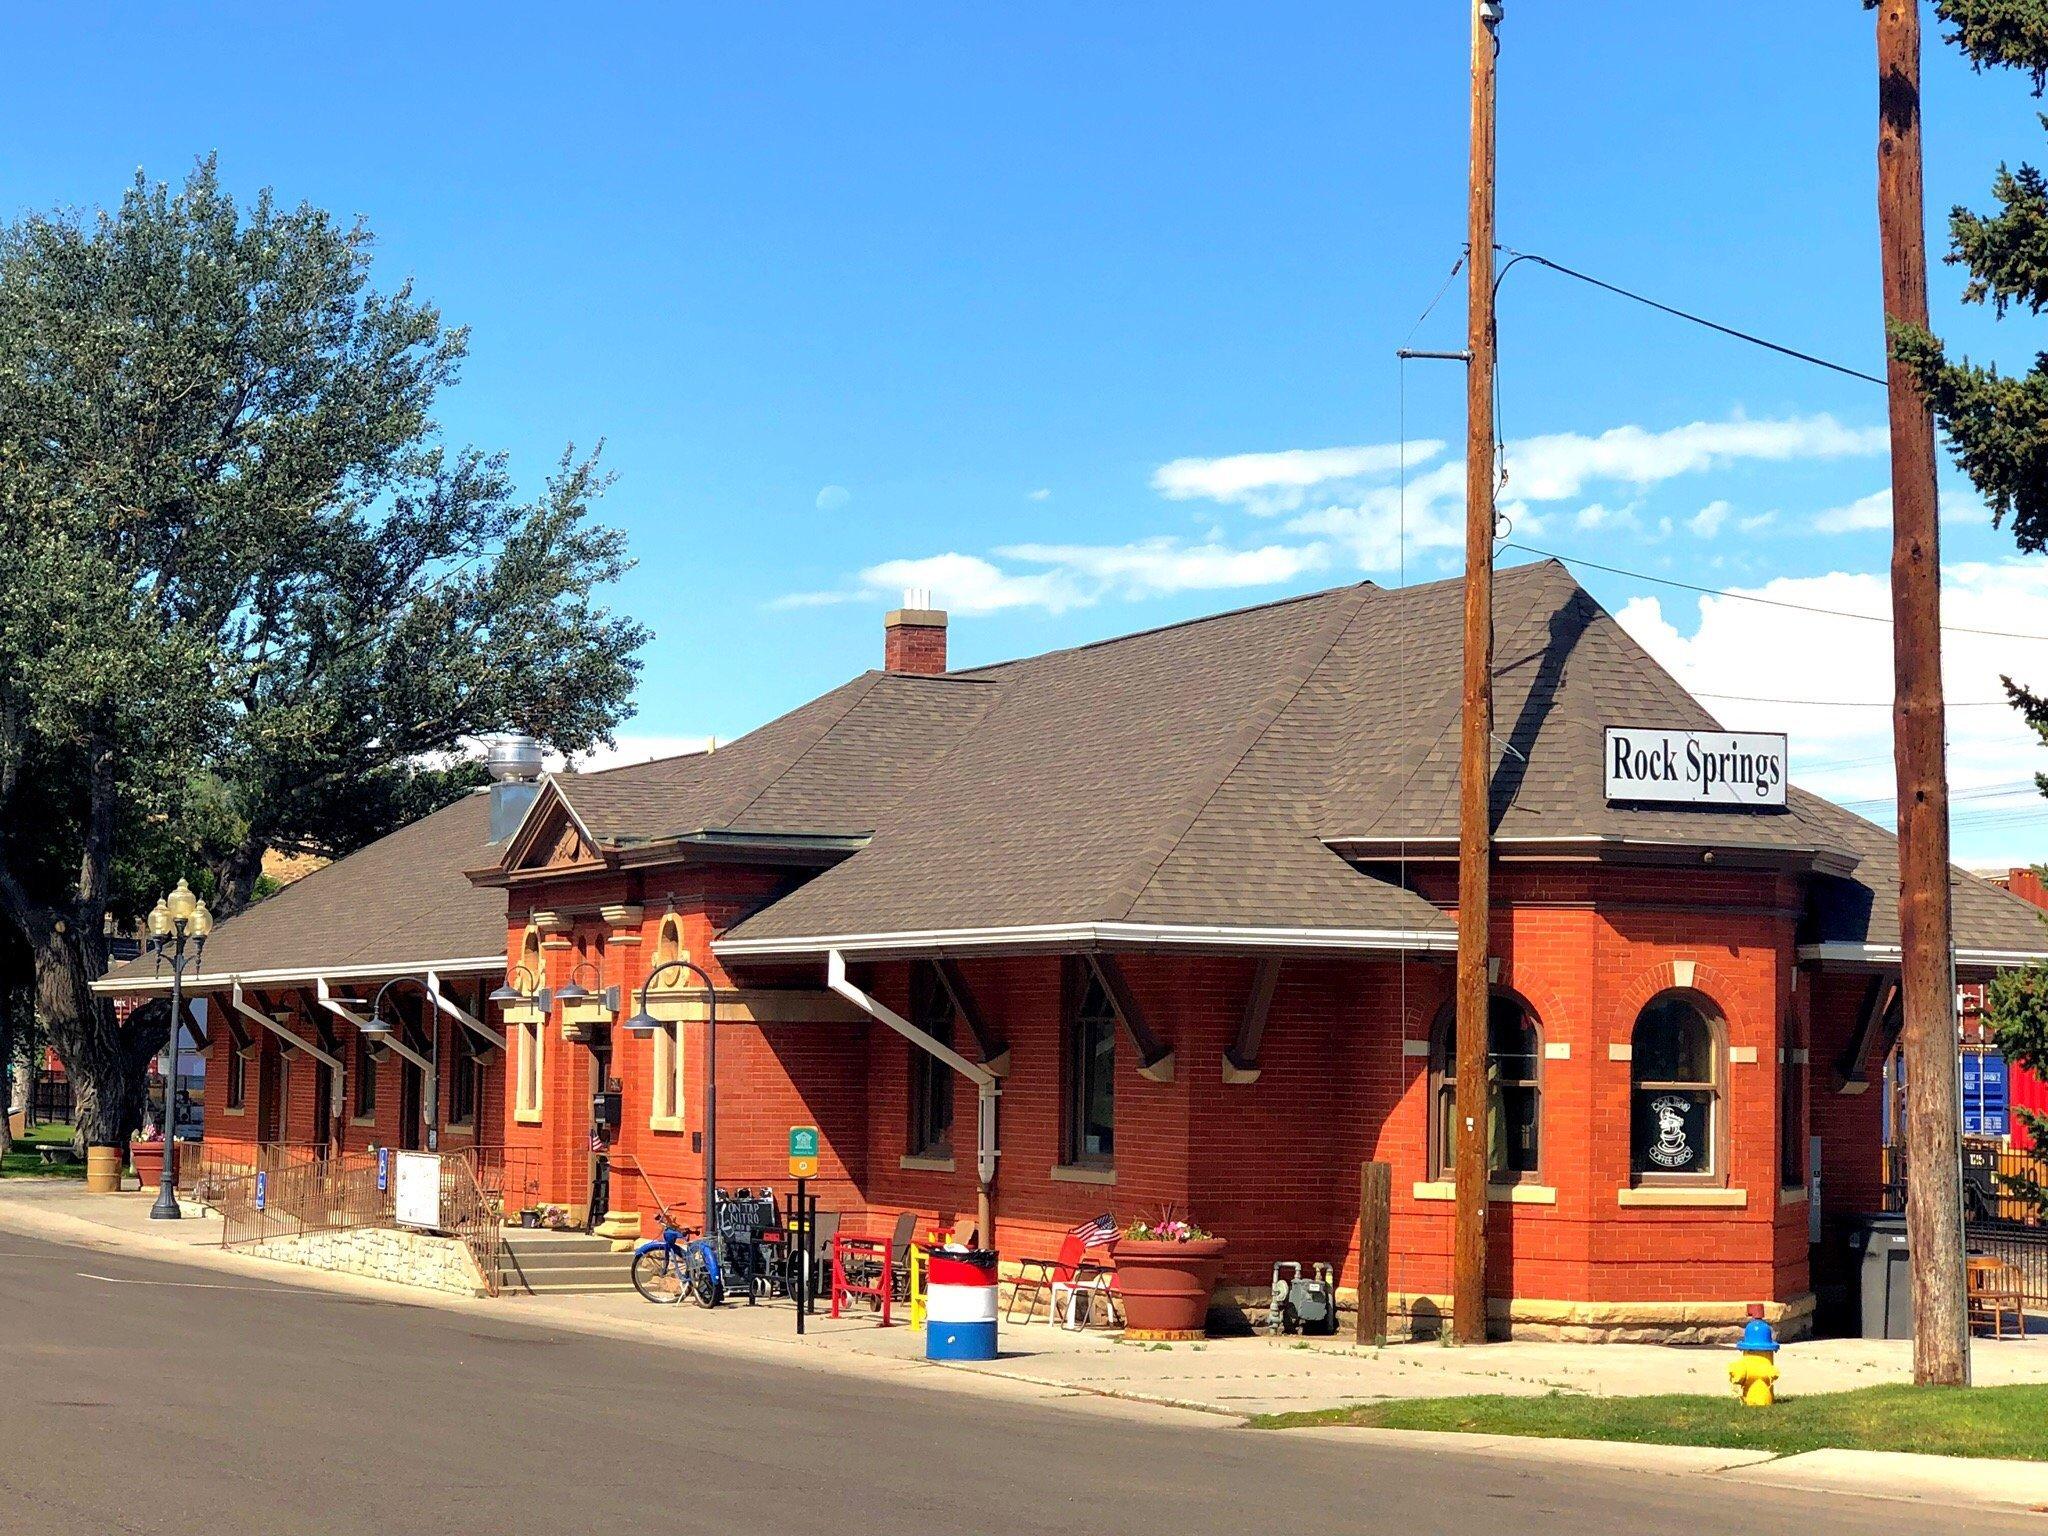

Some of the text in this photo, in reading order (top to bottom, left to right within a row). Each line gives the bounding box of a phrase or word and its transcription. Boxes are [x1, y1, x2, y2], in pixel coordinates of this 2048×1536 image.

[1612, 736, 1780, 797] Rock Springs
[1649, 1145, 1694, 1165] COFFEE DEPOT
[728, 1202, 760, 1213] ON TAP
[730, 1212, 760, 1225] NITRO
